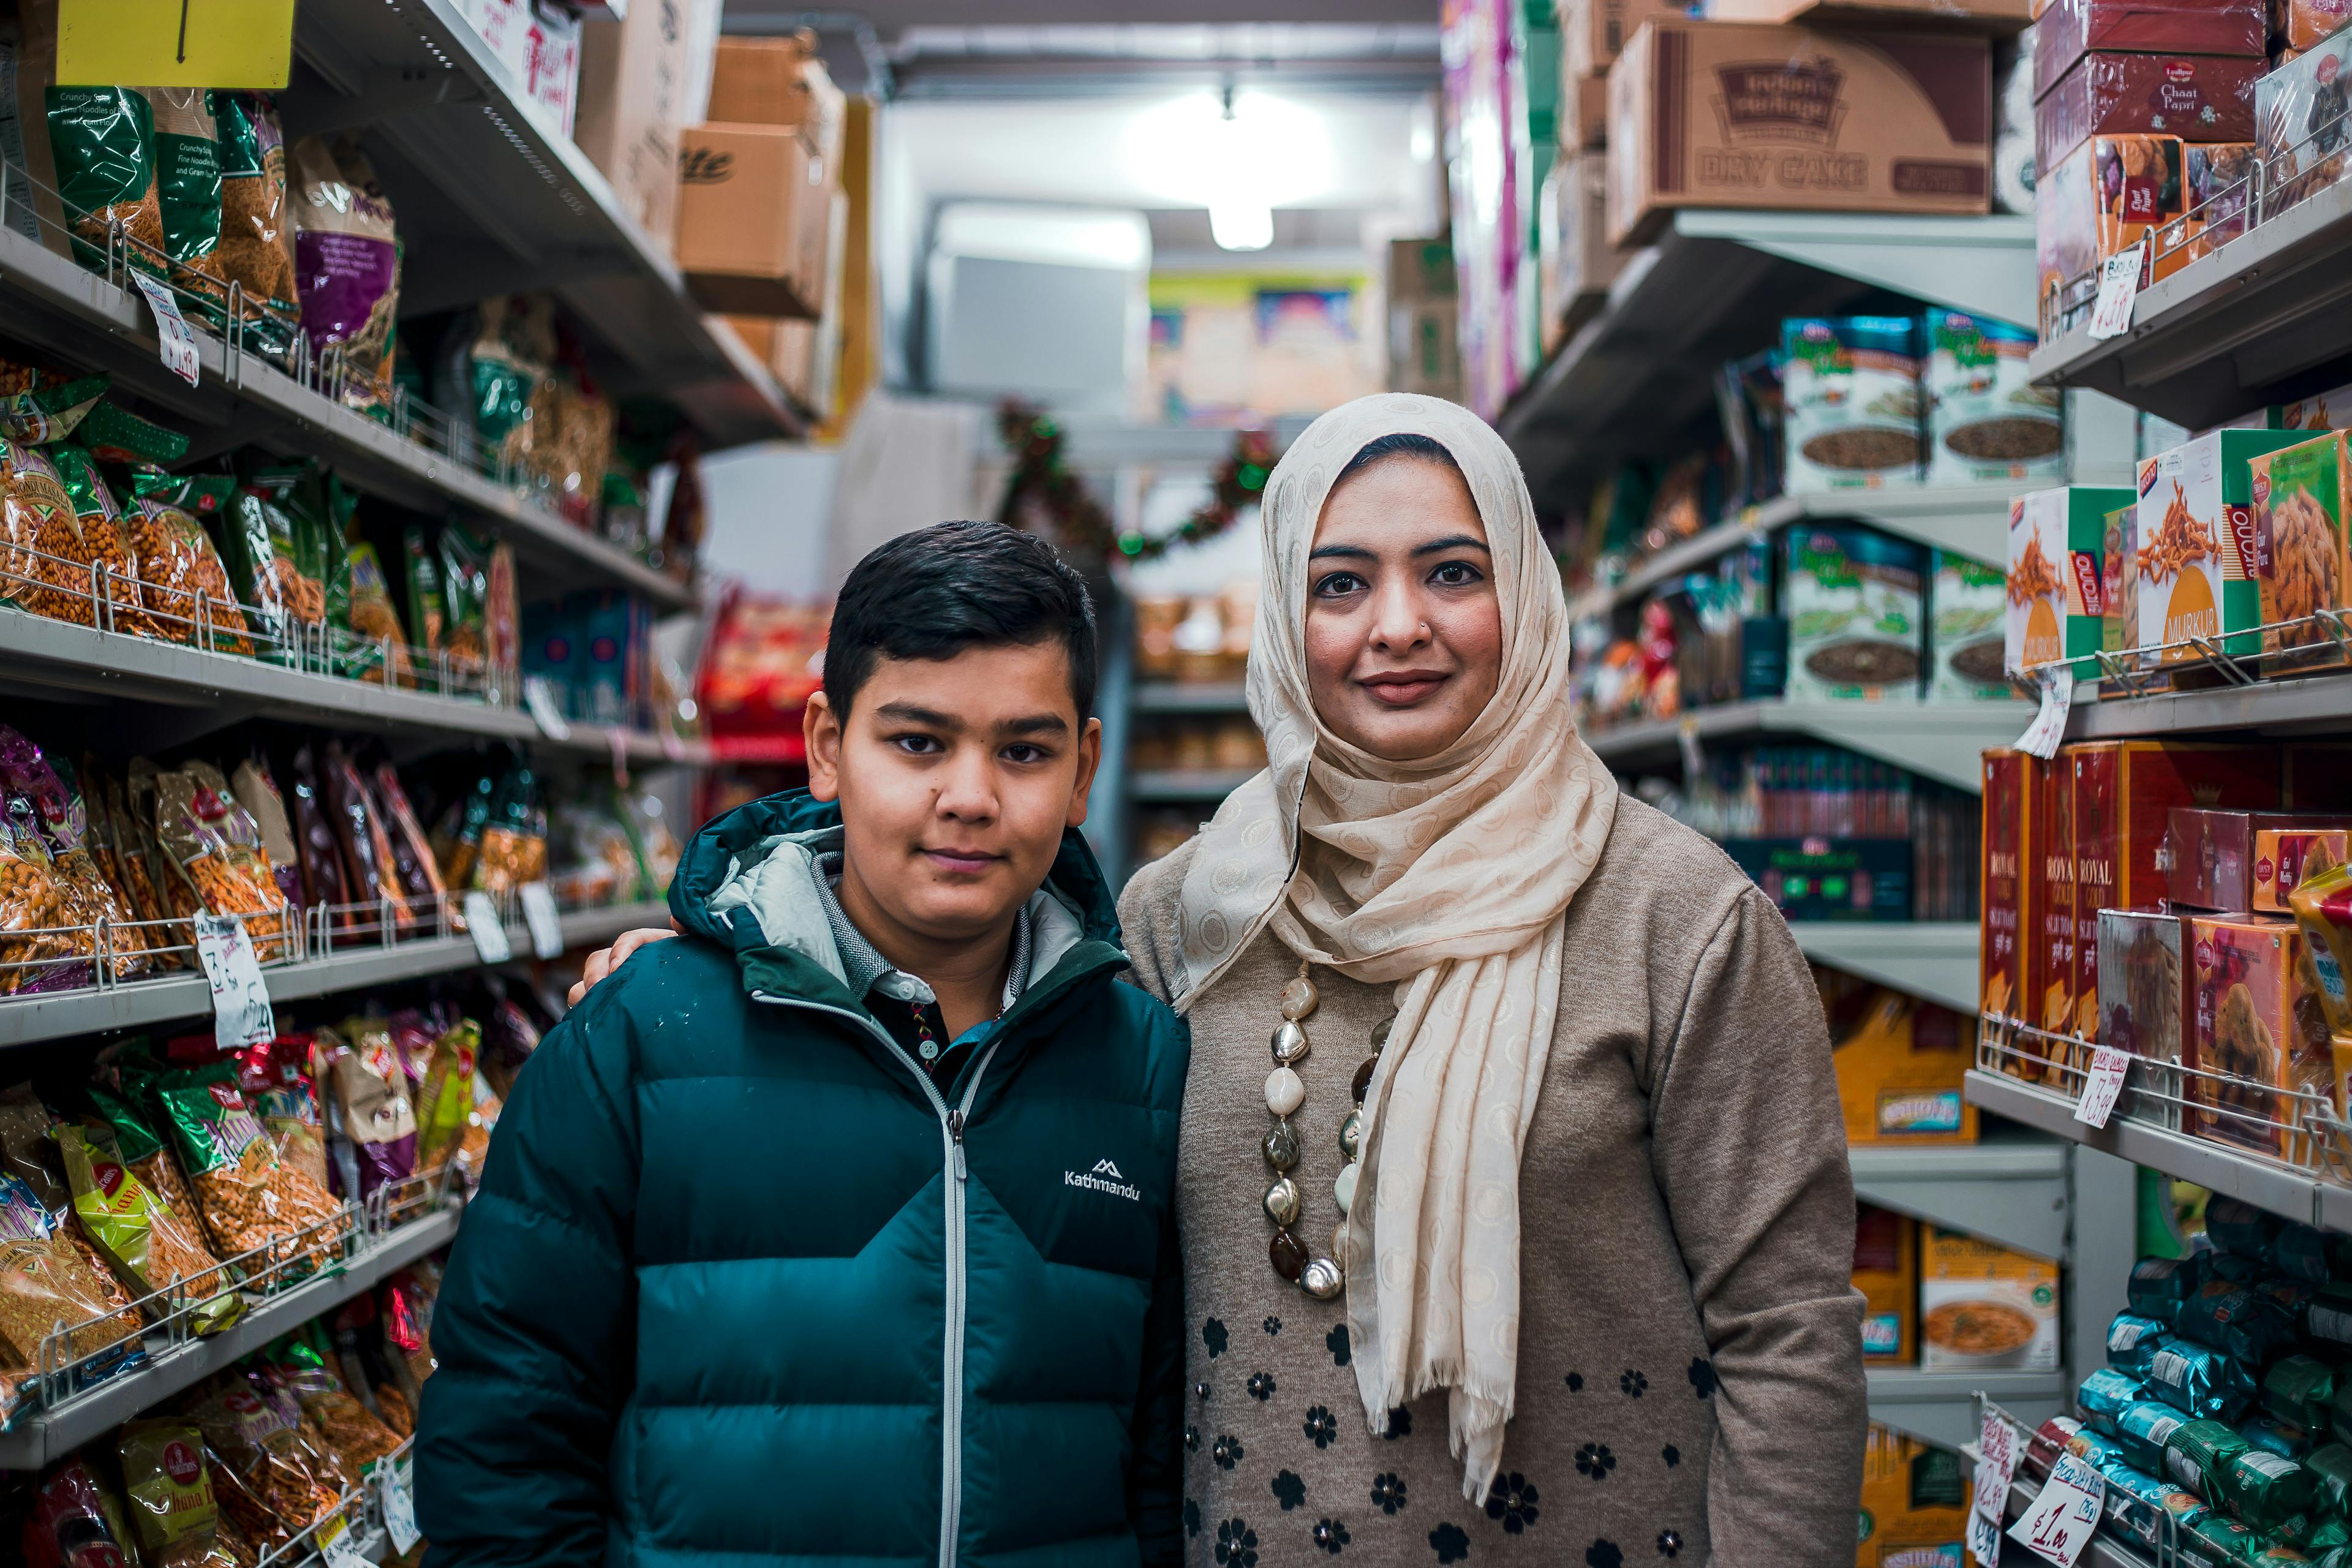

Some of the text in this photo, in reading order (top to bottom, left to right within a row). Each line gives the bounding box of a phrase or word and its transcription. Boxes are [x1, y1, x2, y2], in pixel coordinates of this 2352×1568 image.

[60, 92, 92, 104] Crunchy
[2160, 83, 2198, 99] Chaat
[2163, 96, 2195, 111] Papri
[79, 105, 108, 115] Noodles
[179, 143, 203, 154] Crunchy
[1700, 152, 1771, 186] DRY
[1780, 153, 1868, 189] CAKE
[39, 481, 70, 510] MASALA
[2168, 607, 2215, 643] MURKUR
[2046, 855, 2074, 883] ROYA
[2080, 857, 2113, 886] ROYAL
[2086, 886, 2106, 909] GOLD
[1065, 1170, 1140, 1201] Kathmandu
[2031, 1502, 2068, 1550] $1.00
